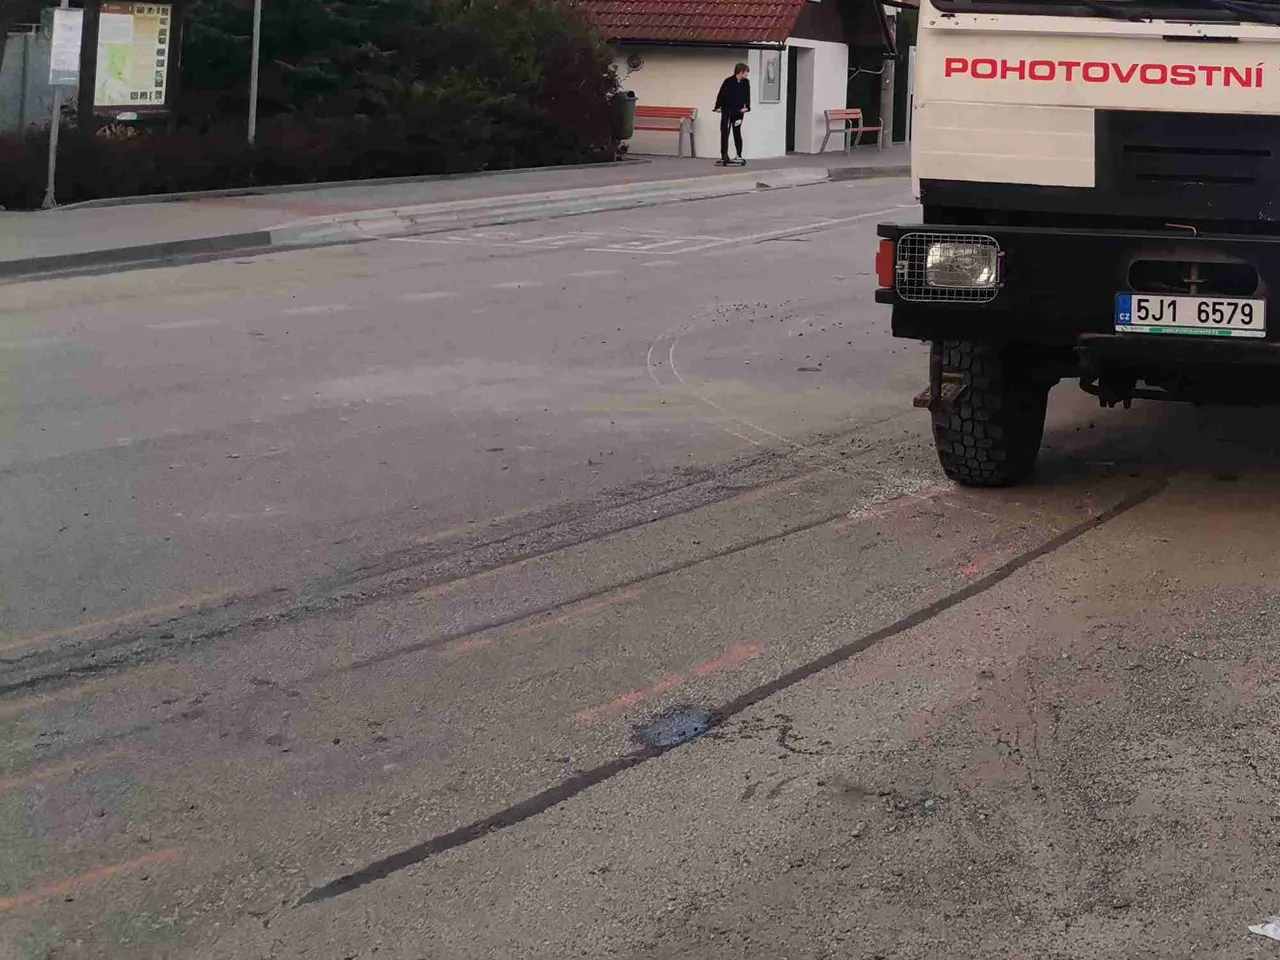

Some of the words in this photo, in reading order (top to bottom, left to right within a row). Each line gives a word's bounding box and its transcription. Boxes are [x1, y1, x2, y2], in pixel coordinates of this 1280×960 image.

[944, 57, 1265, 88] POHOTOVOSTNÍ
[1136, 298, 1178, 323] 5J1
[1197, 301, 1254, 325] 6579
